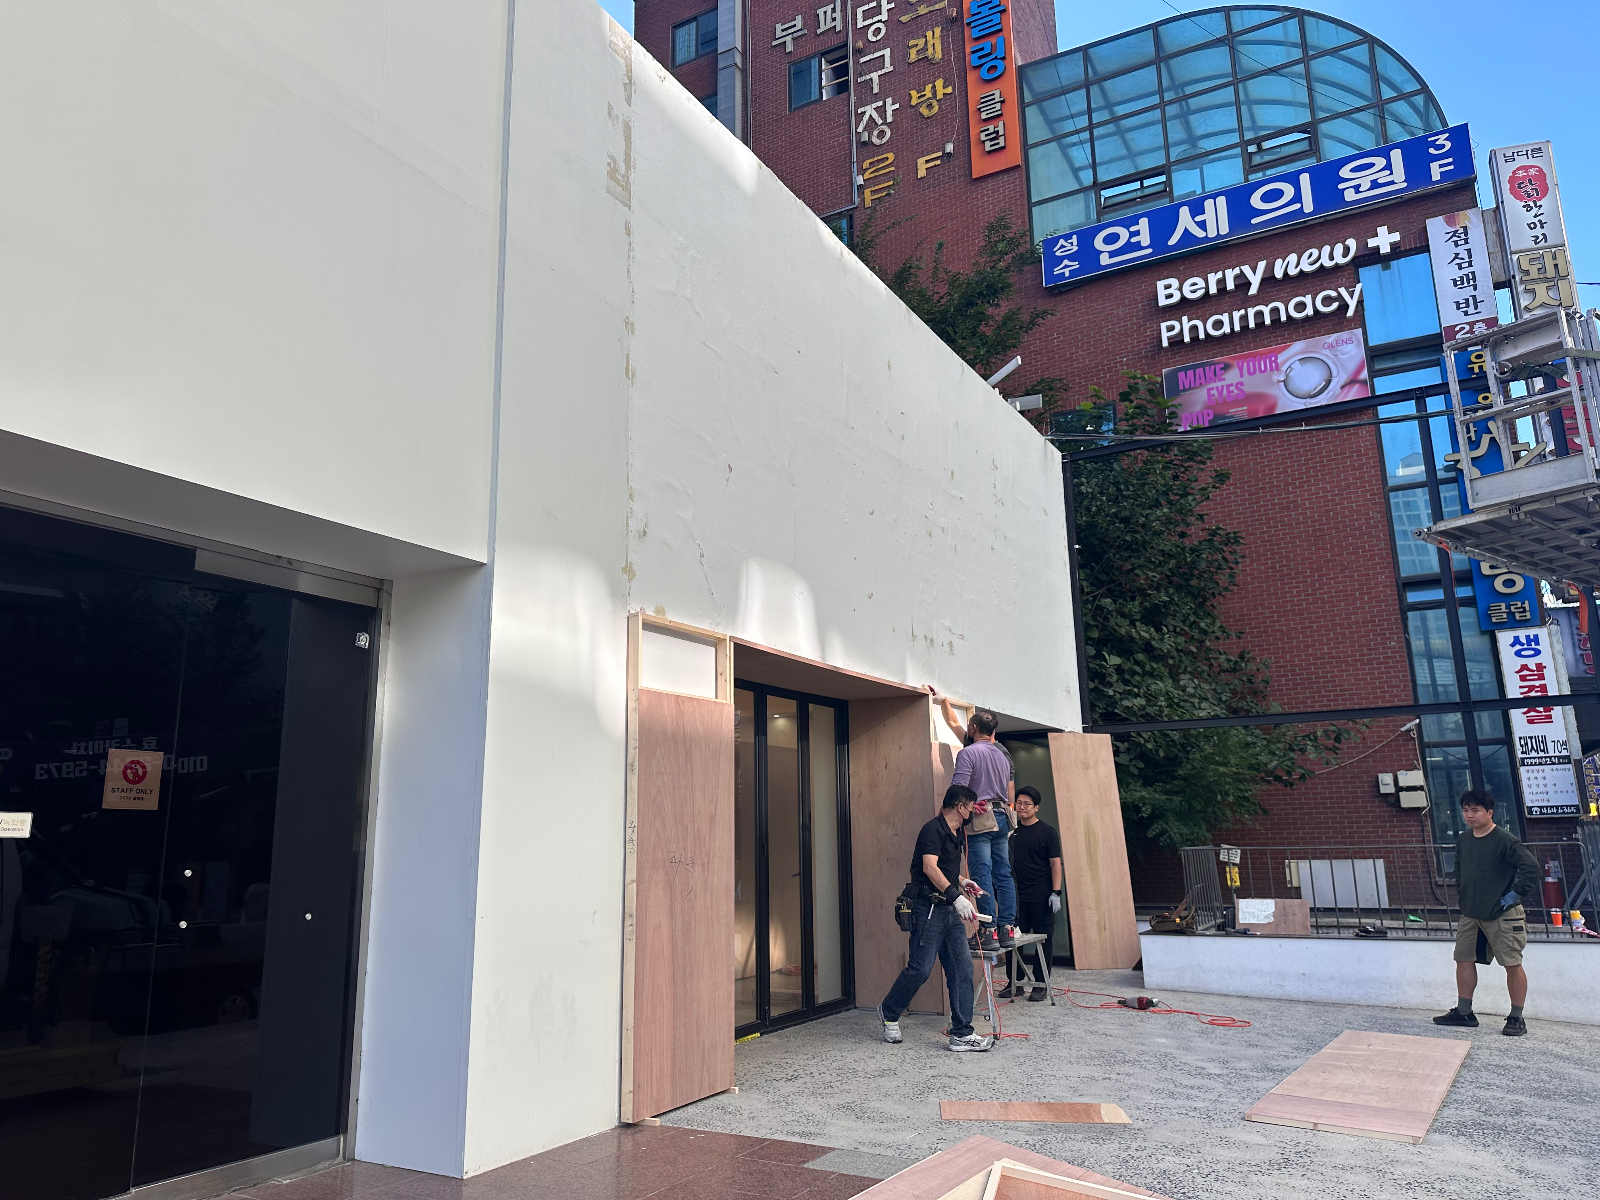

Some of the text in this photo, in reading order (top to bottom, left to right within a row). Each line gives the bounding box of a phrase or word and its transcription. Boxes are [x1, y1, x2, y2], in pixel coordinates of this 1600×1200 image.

[855, 0, 900, 146] 당구장
[1503, 146, 1544, 163] 남다른
[1053, 132, 1455, 277] 성수 연세의원 3F
[1156, 236, 1357, 308] Berry new
[1444, 225, 1485, 317] 점심백반
[1159, 282, 1364, 348] Pharmacy
[1178, 353, 1280, 391] MAKE YOUR
[1206, 380, 1246, 407] EYES
[1182, 408, 1214, 431] POP
[1518, 734, 1549, 755] 돼지네
